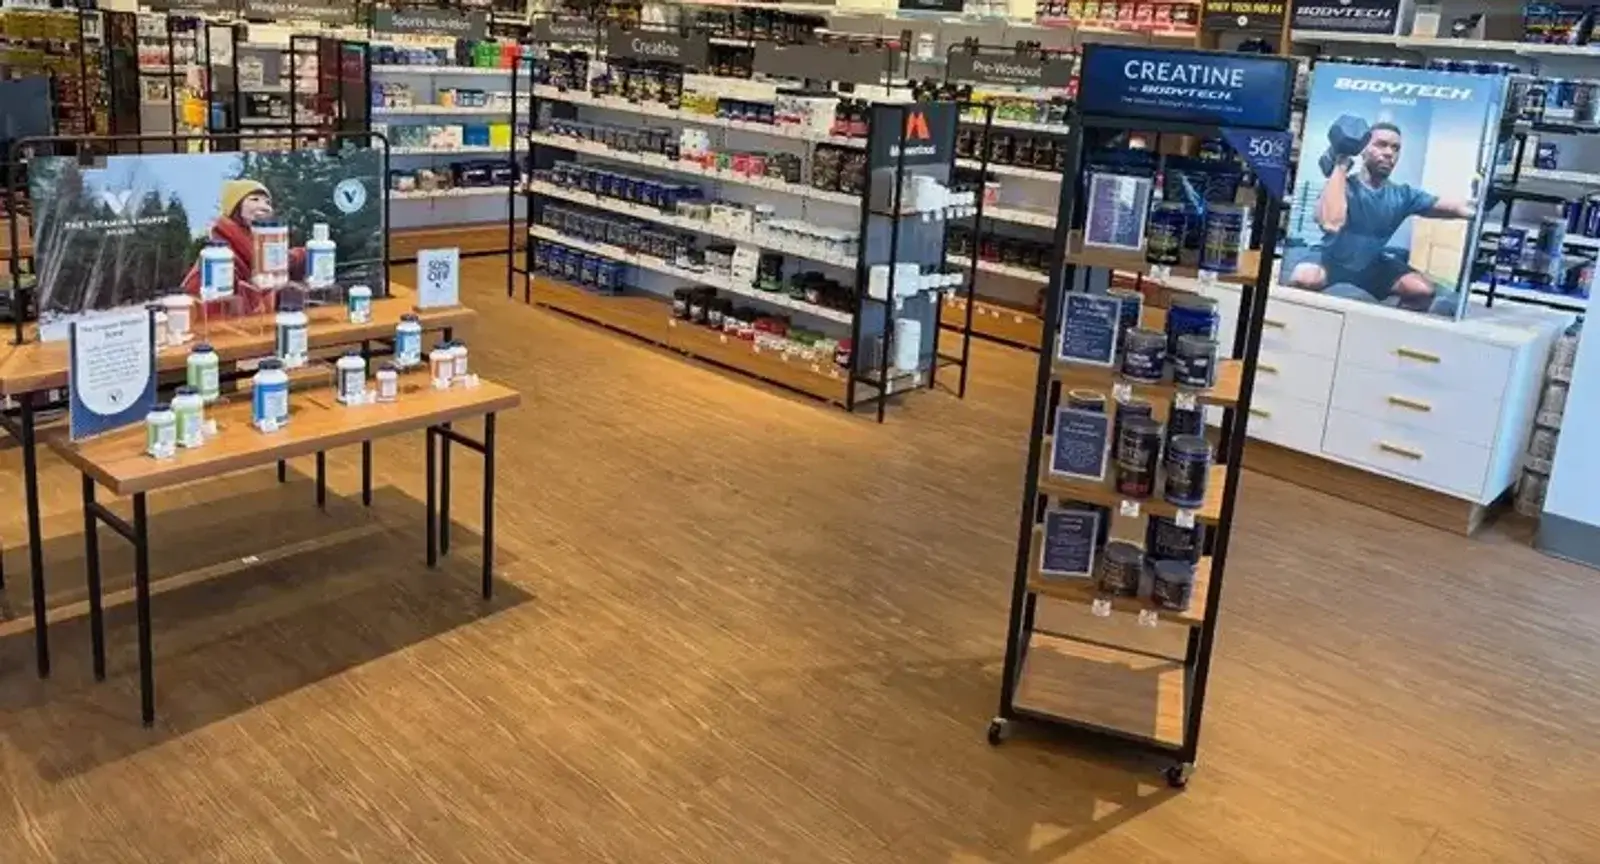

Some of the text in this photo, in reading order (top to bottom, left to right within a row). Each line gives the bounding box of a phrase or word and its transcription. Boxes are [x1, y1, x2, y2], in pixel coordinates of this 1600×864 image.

[1297, 6, 1391, 18] BODYTECH
[392, 15, 471, 31] Sports Nutrition
[631, 38, 680, 57] Creatine
[973, 60, 1042, 77] Pre-Workout
[1124, 60, 1244, 88] CREATINE
[1140, 84, 1232, 101] BODYTECH
[1335, 77, 1474, 101] BODYTECH
[427, 270, 449, 283] OFF
